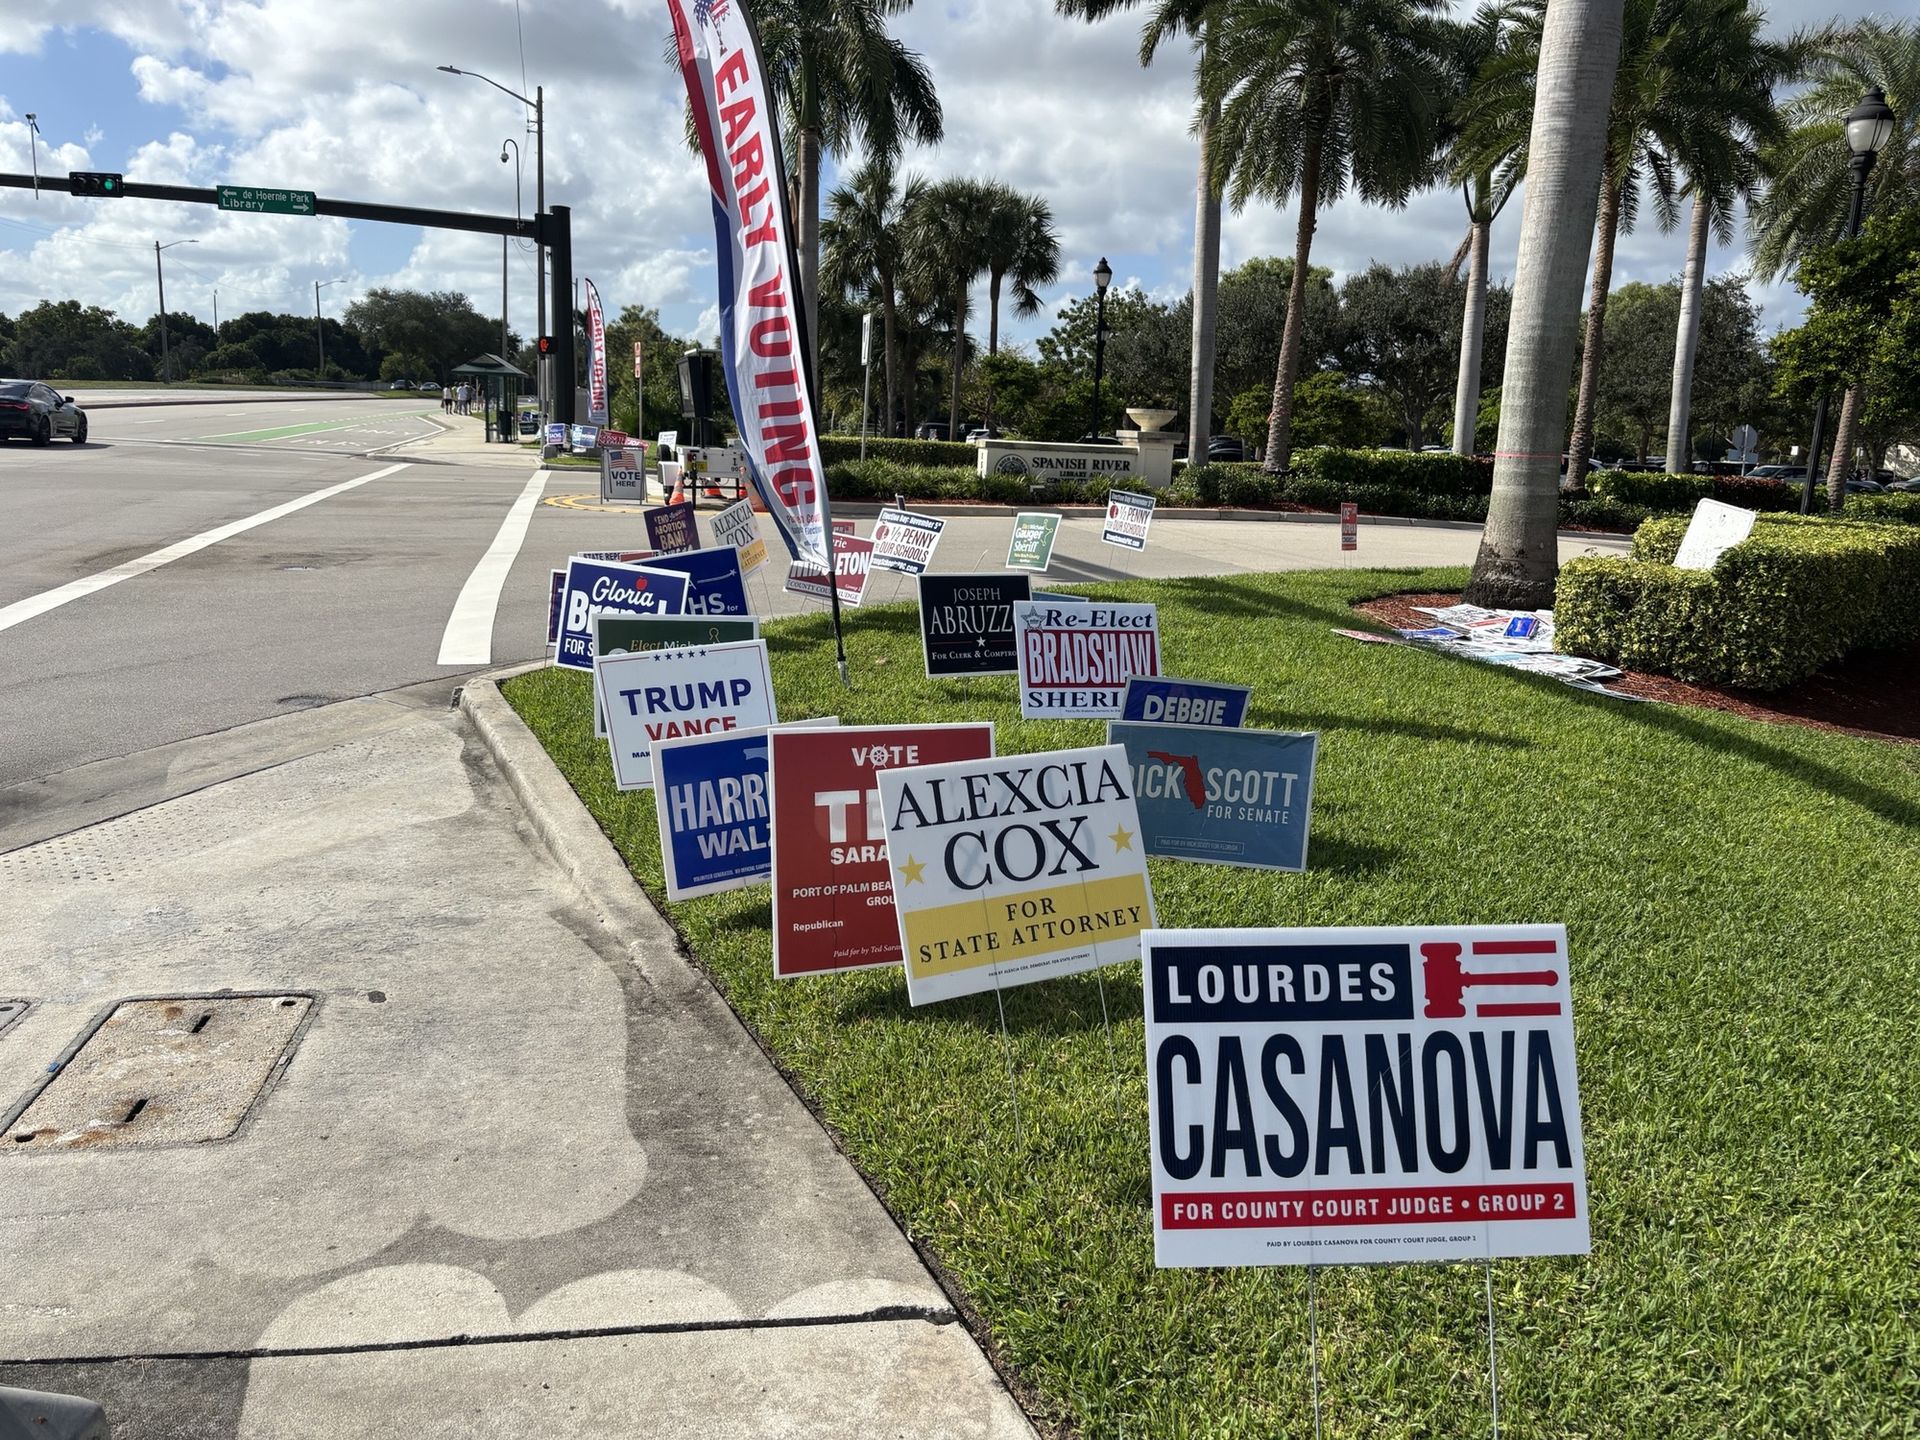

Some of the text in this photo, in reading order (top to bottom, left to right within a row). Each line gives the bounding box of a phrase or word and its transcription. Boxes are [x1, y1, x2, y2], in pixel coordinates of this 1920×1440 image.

[715, 48, 779, 249] EARLY
[222, 198, 265, 211] Library
[242, 190, 253, 199] de
[290, 192, 310, 203] Park
[592, 358, 605, 411] VOTING
[748, 264, 816, 509] VOTING
[1031, 456, 1087, 470] SPANISH
[1092, 459, 1131, 472] RIVER
[611, 471, 641, 481] VOTE
[1059, 470, 1087, 478] LIBRARY
[615, 480, 636, 488] HERE
[714, 503, 754, 537] ALEXCIA
[881, 511, 900, 521] Election
[910, 516, 934, 528] November
[1127, 507, 1151, 525] PENNY
[655, 520, 687, 535] ABORTION
[726, 522, 754, 547] COX
[1015, 527, 1045, 541] Gauger
[1113, 519, 1123, 531] OUR
[1123, 522, 1146, 537] SCHOOLS
[660, 530, 686, 550] BAN!
[900, 527, 936, 549] PENNY
[1013, 540, 1040, 552] Sheriff
[583, 553, 604, 561] STATE
[879, 541, 895, 555] OUR
[894, 543, 929, 563] SCHOOLS
[592, 575, 655, 608] Gloria
[789, 580, 815, 591] COUNTY
[953, 587, 1001, 604] JOSEPH
[726, 603, 739, 612] for
[929, 604, 1016, 636] ABRUZZ
[1045, 608, 1154, 629] Re-Elect
[564, 638, 585, 655] FOR
[630, 638, 661, 652] Elect
[974, 650, 982, 659] &
[1026, 629, 1152, 685] BRADSHAW
[619, 678, 753, 717] TRUMP
[1027, 690, 1121, 709] SHERI
[1142, 694, 1227, 725] DEBBIE
[644, 715, 738, 742] VANCE
[631, 750, 651, 759] MAK
[891, 758, 1131, 832] ALEXCIA
[1204, 767, 1299, 808] SCOTT
[669, 771, 769, 833] HARR
[1207, 804, 1290, 825] FOR SENATE
[830, 845, 890, 866] SARA
[943, 815, 1100, 891] COX
[792, 880, 893, 899] PORT OF PALM BEA
[866, 894, 896, 907] GROU
[1005, 897, 1058, 922] FOR
[792, 918, 845, 932] Republican
[920, 905, 1142, 964] STATE ATTORNEY
[833, 948, 849, 959] Paid
[848, 947, 860, 959] for
[860, 946, 870, 957] by
[870, 944, 882, 954] Ted
[1071, 953, 1091, 961] ATTORNEY
[1167, 962, 1397, 1005] LOURDES
[1155, 1029, 1574, 1181] CASANOVA
[1173, 1193, 1566, 1221] FOR COUNTY COURT JUDGE GROUP 2
